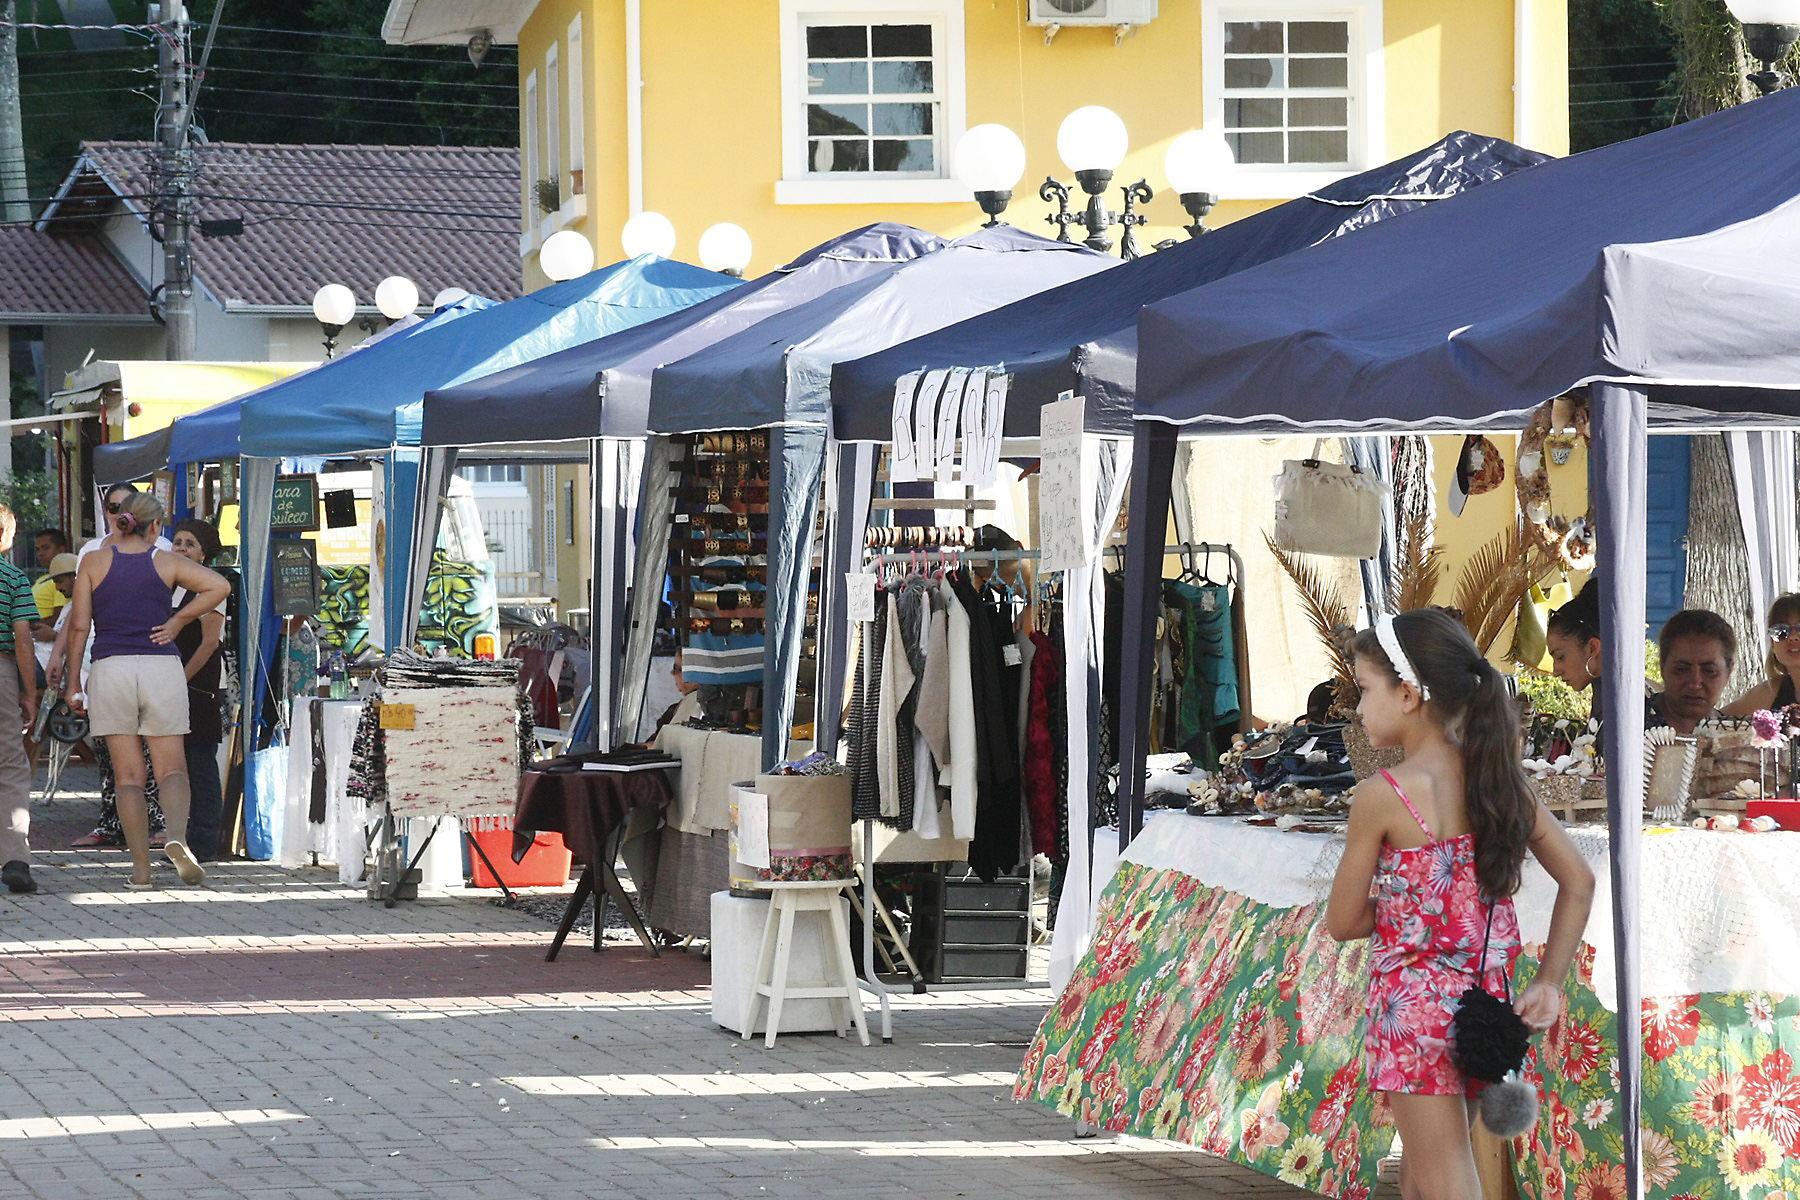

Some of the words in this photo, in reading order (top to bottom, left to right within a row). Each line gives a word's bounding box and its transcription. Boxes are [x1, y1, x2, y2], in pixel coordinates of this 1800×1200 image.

[894, 384, 1000, 475] BAZAR
[275, 487, 302, 498] ara
[277, 500, 294, 511] de
